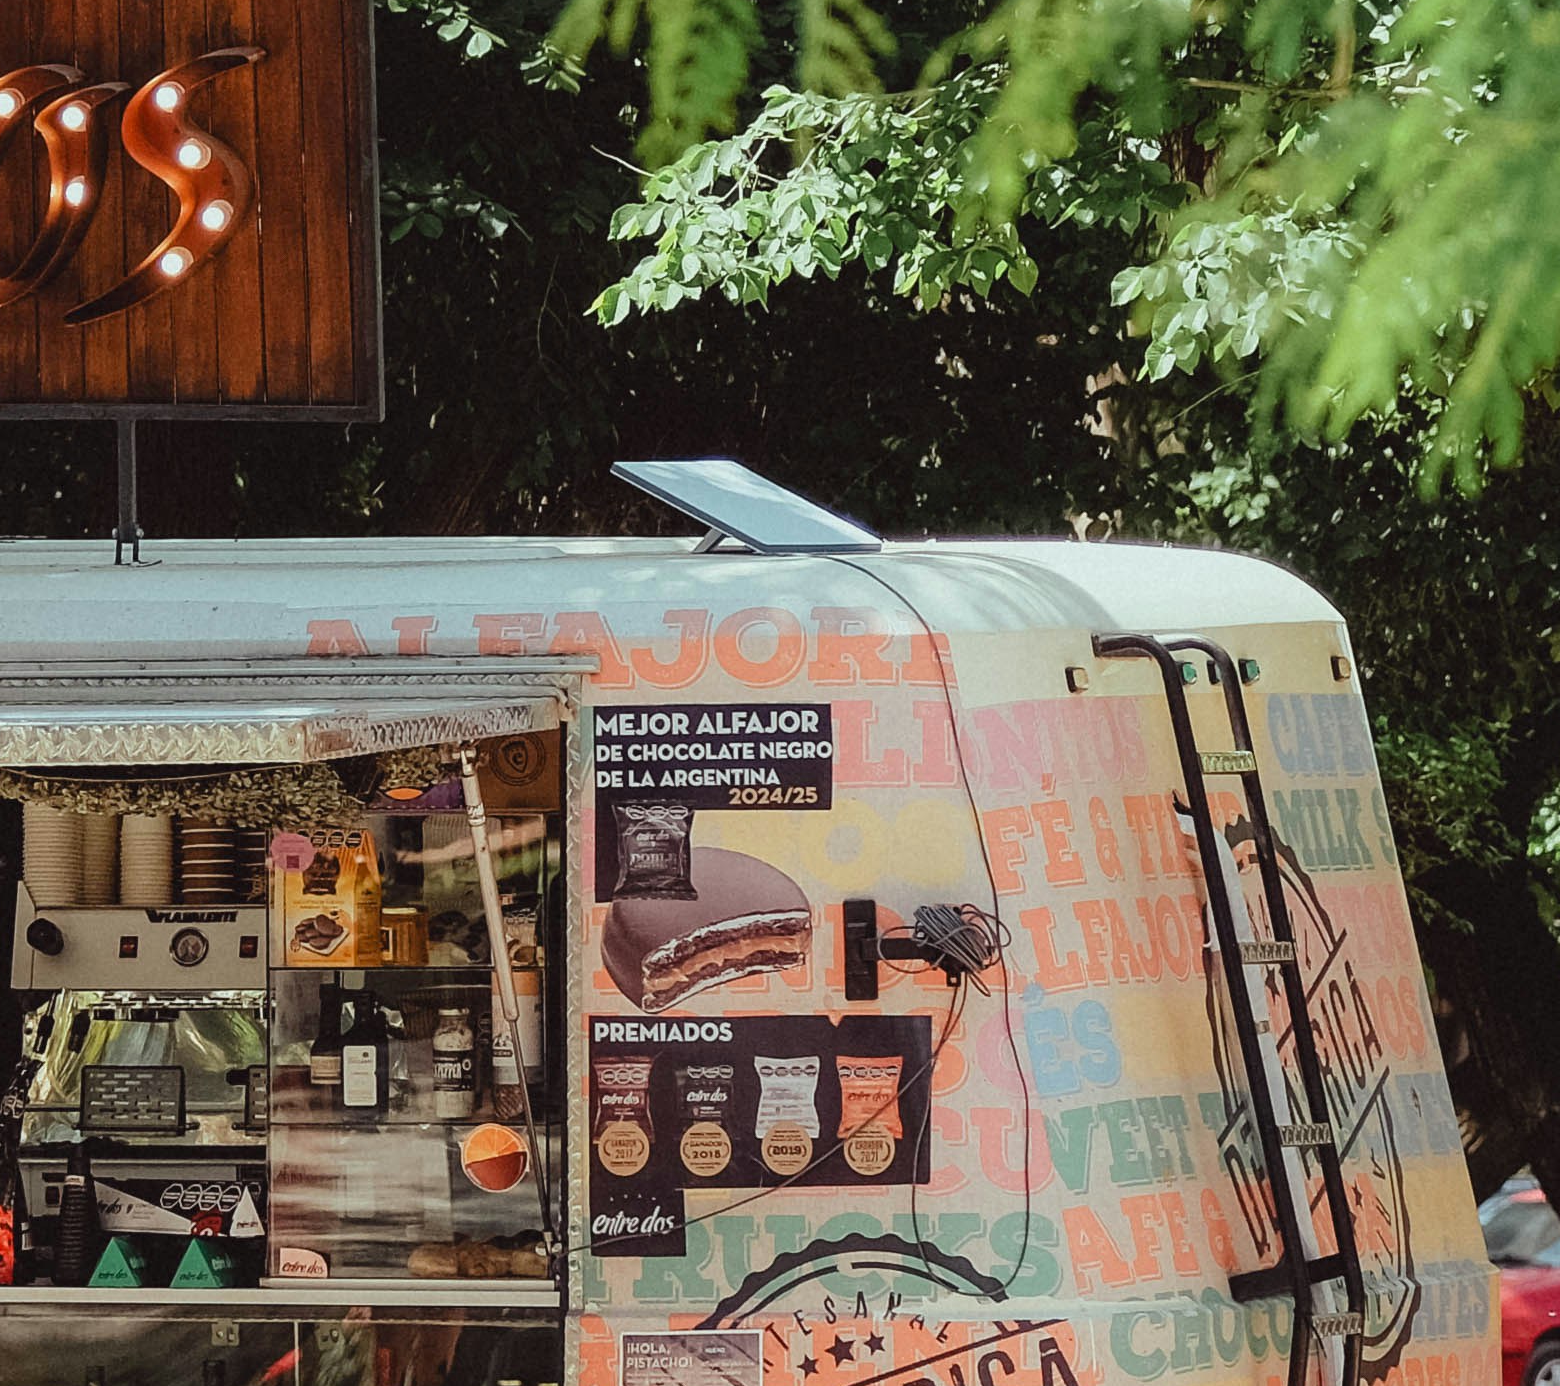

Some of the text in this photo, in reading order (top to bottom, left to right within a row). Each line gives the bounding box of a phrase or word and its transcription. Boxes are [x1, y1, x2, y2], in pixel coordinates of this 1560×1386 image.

[595, 710, 819, 737] MEJOR ALFAJOR
[595, 741, 833, 762] DE CHOCOLATE NEGRO
[596, 768, 781, 788] DE LA ARGENTINA
[728, 787, 818, 805] 2024/25
[594, 1021, 733, 1043] PREMIADOS
[592, 1205, 675, 1236] entre dos
[626, 1342, 671, 1355] ¡HOLA,
[625, 1356, 693, 1369] PISTACHO!
